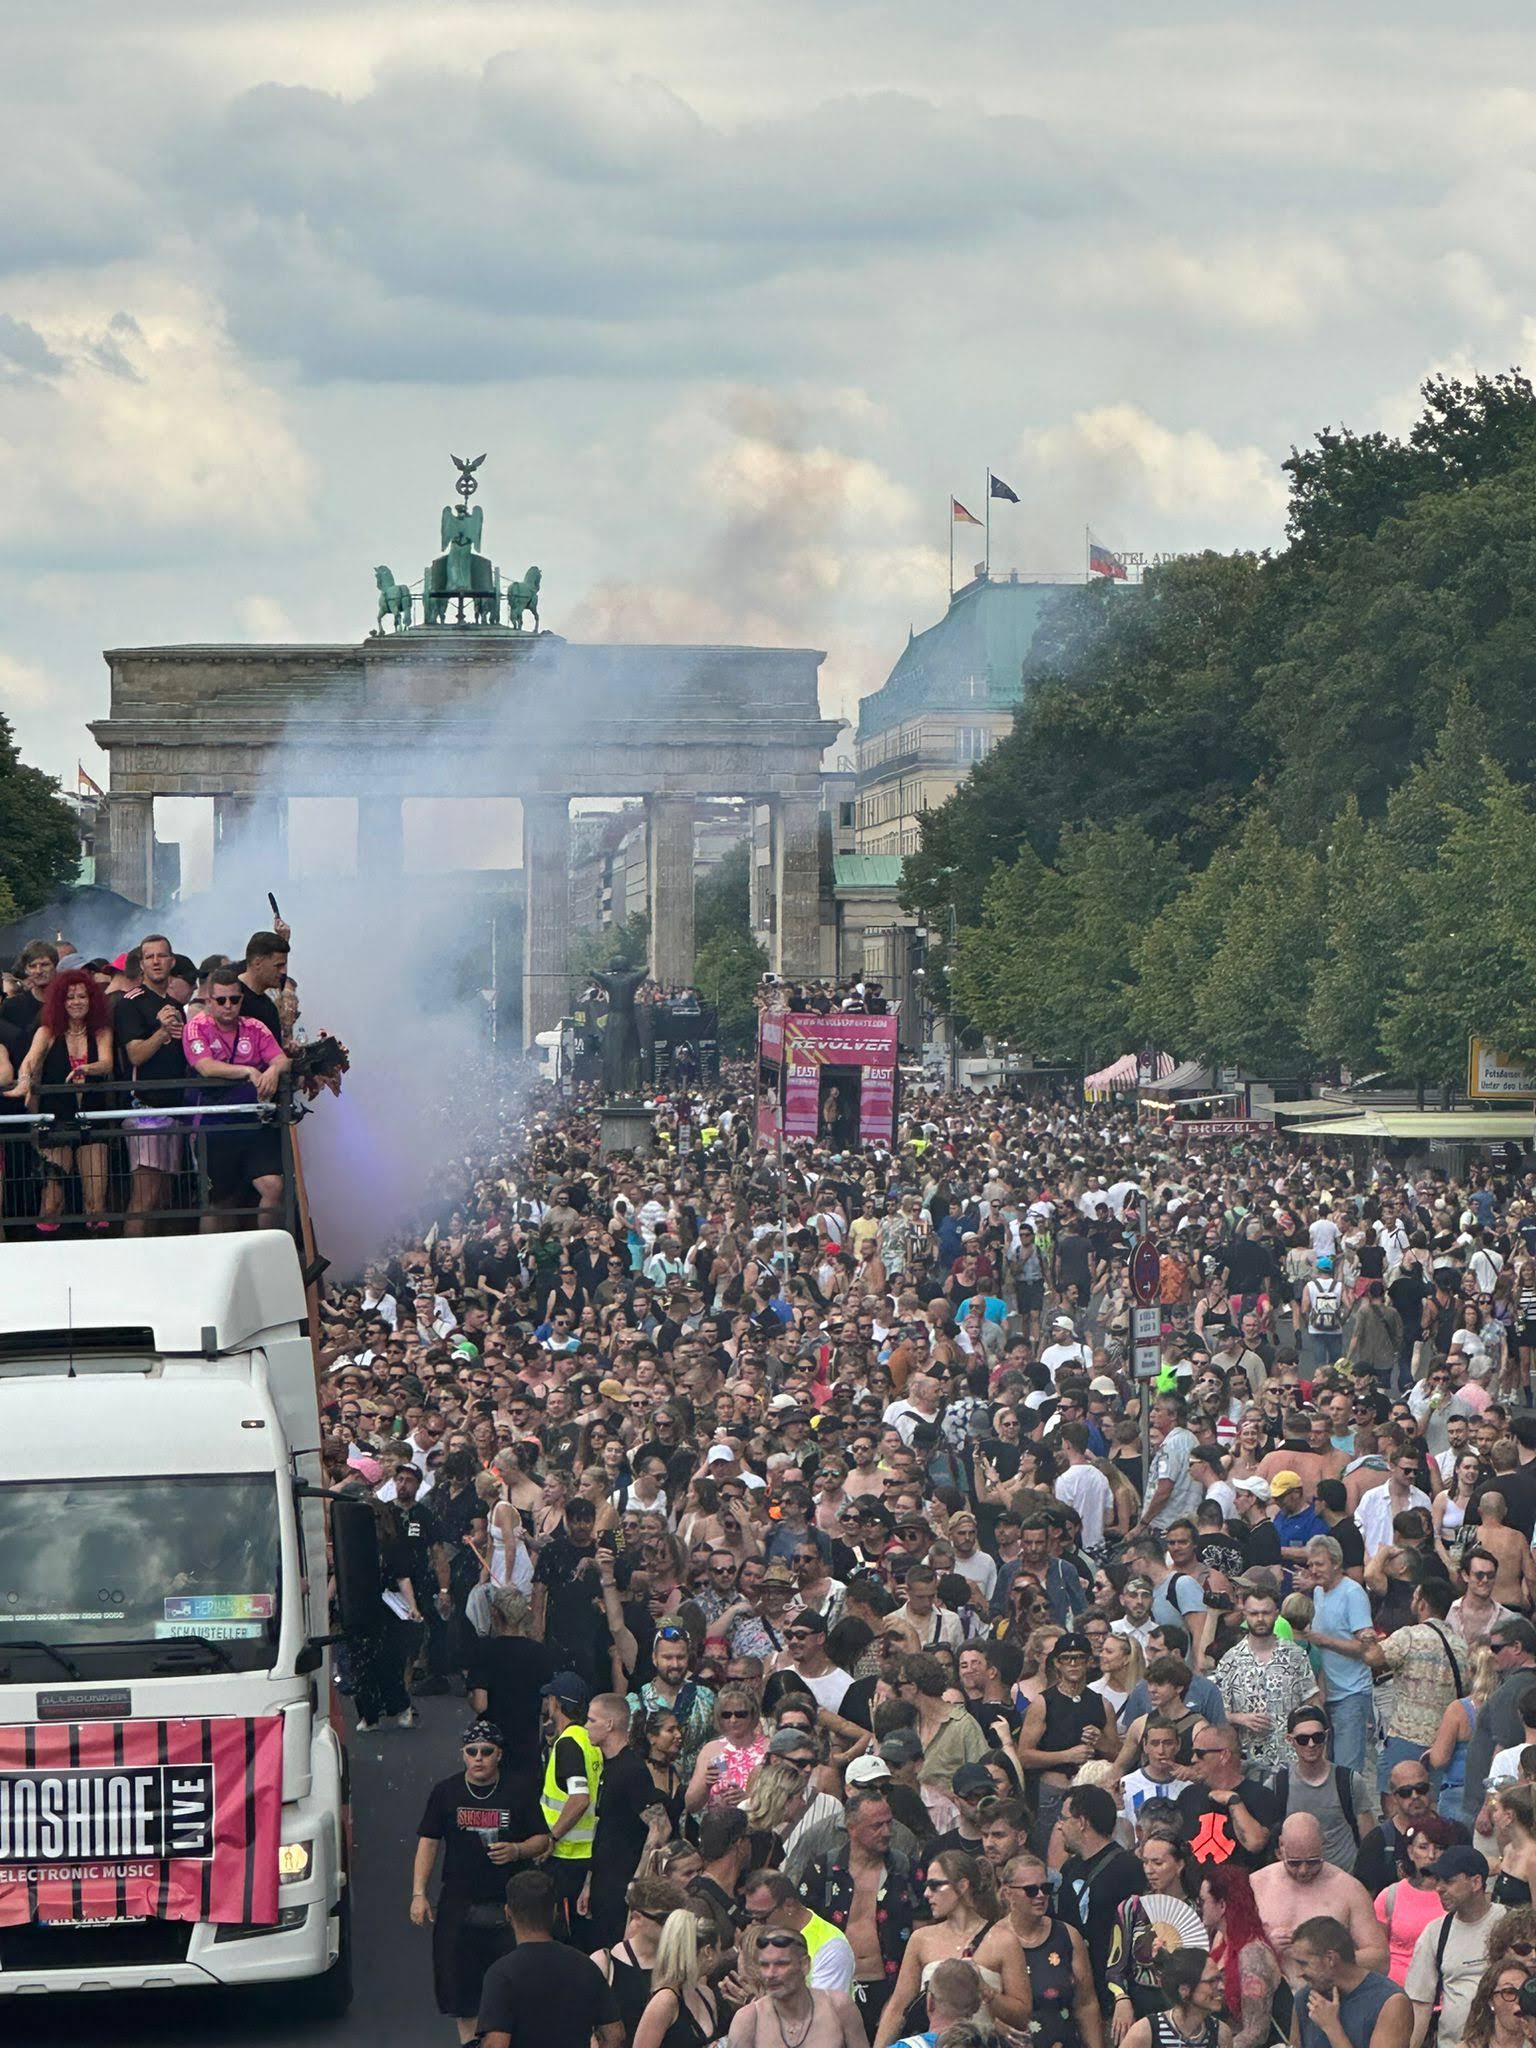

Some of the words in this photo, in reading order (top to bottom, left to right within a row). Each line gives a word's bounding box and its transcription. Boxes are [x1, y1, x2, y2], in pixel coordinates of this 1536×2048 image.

[791, 1036, 892, 1051] REVOLVER
[1504, 1082, 1515, 1090] den
[1188, 1122, 1255, 1134] BREZEL
[170, 1625, 248, 1640] SCHAUSTELLER
[42, 1693, 128, 1705] ALLROUNDER
[172, 1779, 205, 1849] LIVE
[0, 1869, 98, 1883] ELECTRONIC
[103, 1865, 154, 1877] MUSIC
